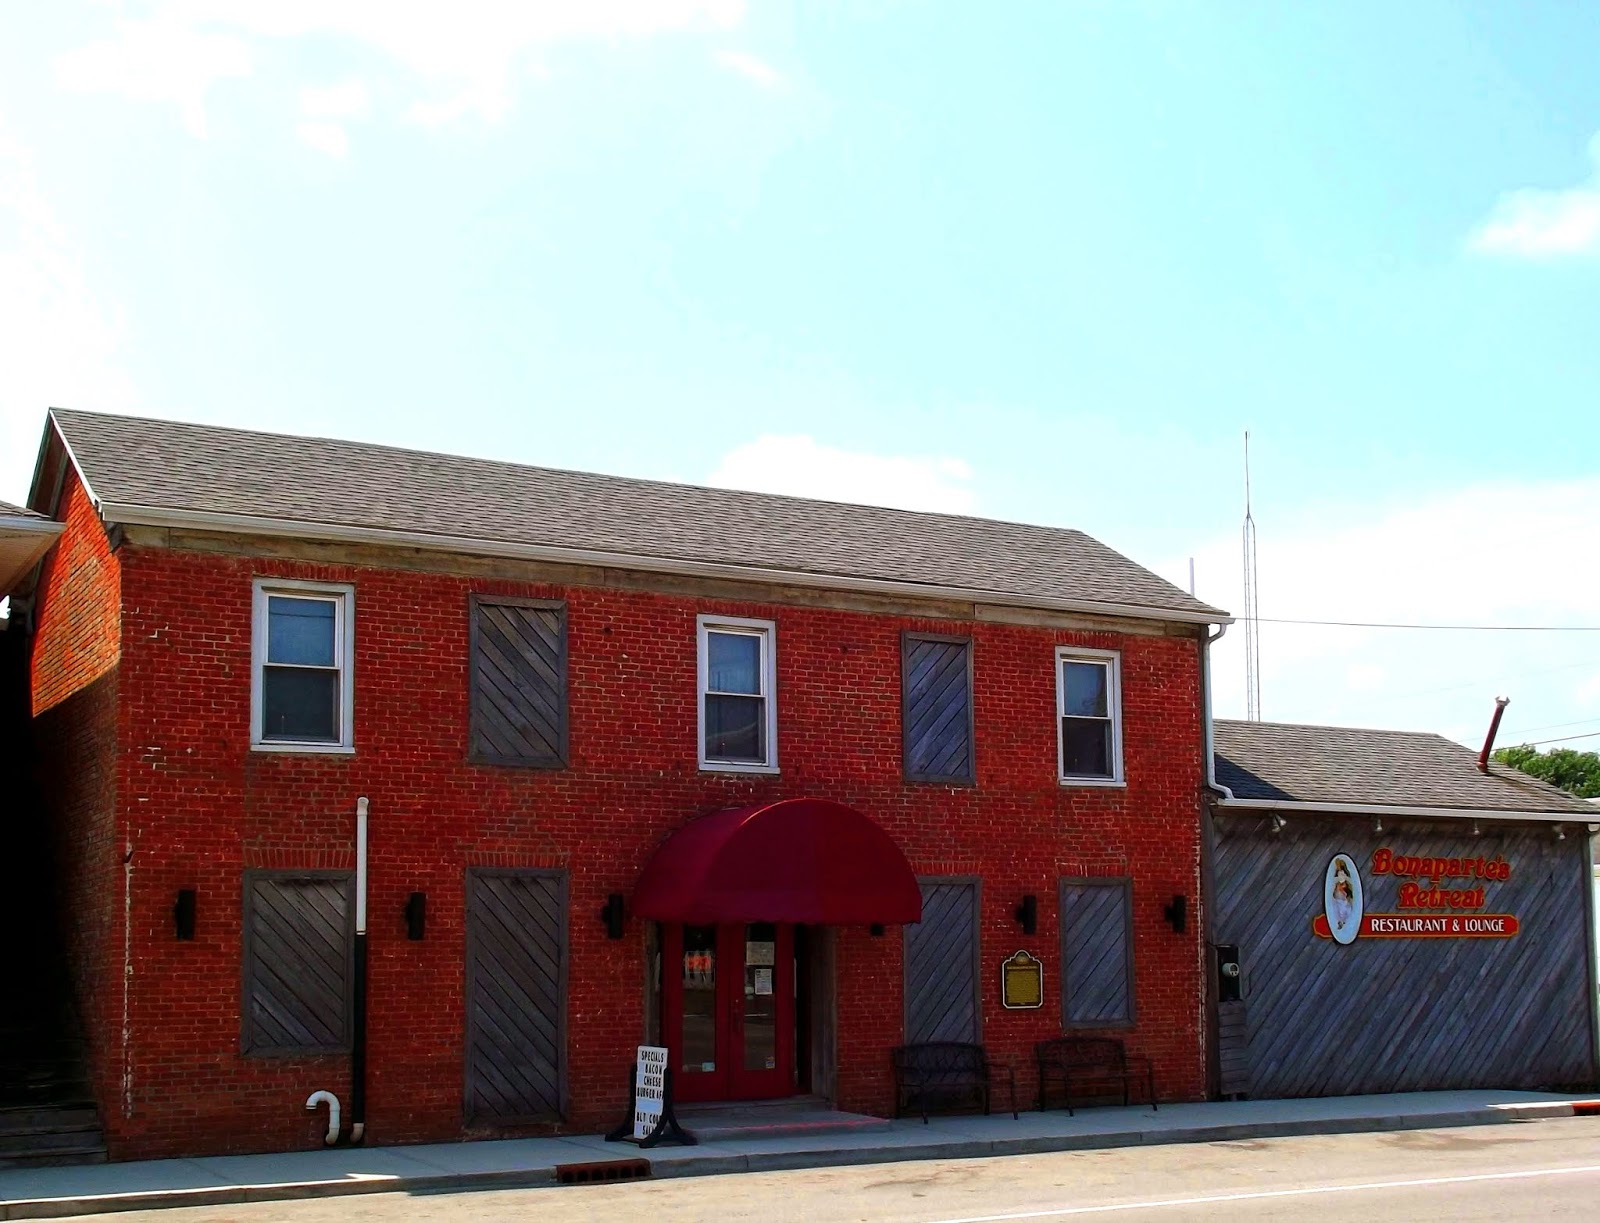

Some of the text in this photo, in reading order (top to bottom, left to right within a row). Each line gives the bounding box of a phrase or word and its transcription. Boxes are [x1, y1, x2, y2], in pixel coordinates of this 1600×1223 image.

[1371, 847, 1511, 882] Bonaparte's
[1397, 881, 1486, 909] Retreat
[1371, 919, 1505, 932] RESTAURANT & LOUNGE
[641, 1051, 664, 1062] SPECIALS
[645, 1064, 662, 1074] BACON
[643, 1076, 661, 1087] CHEESE
[637, 1087, 656, 1099] BURGER
[636, 1112, 646, 1122] BLT
